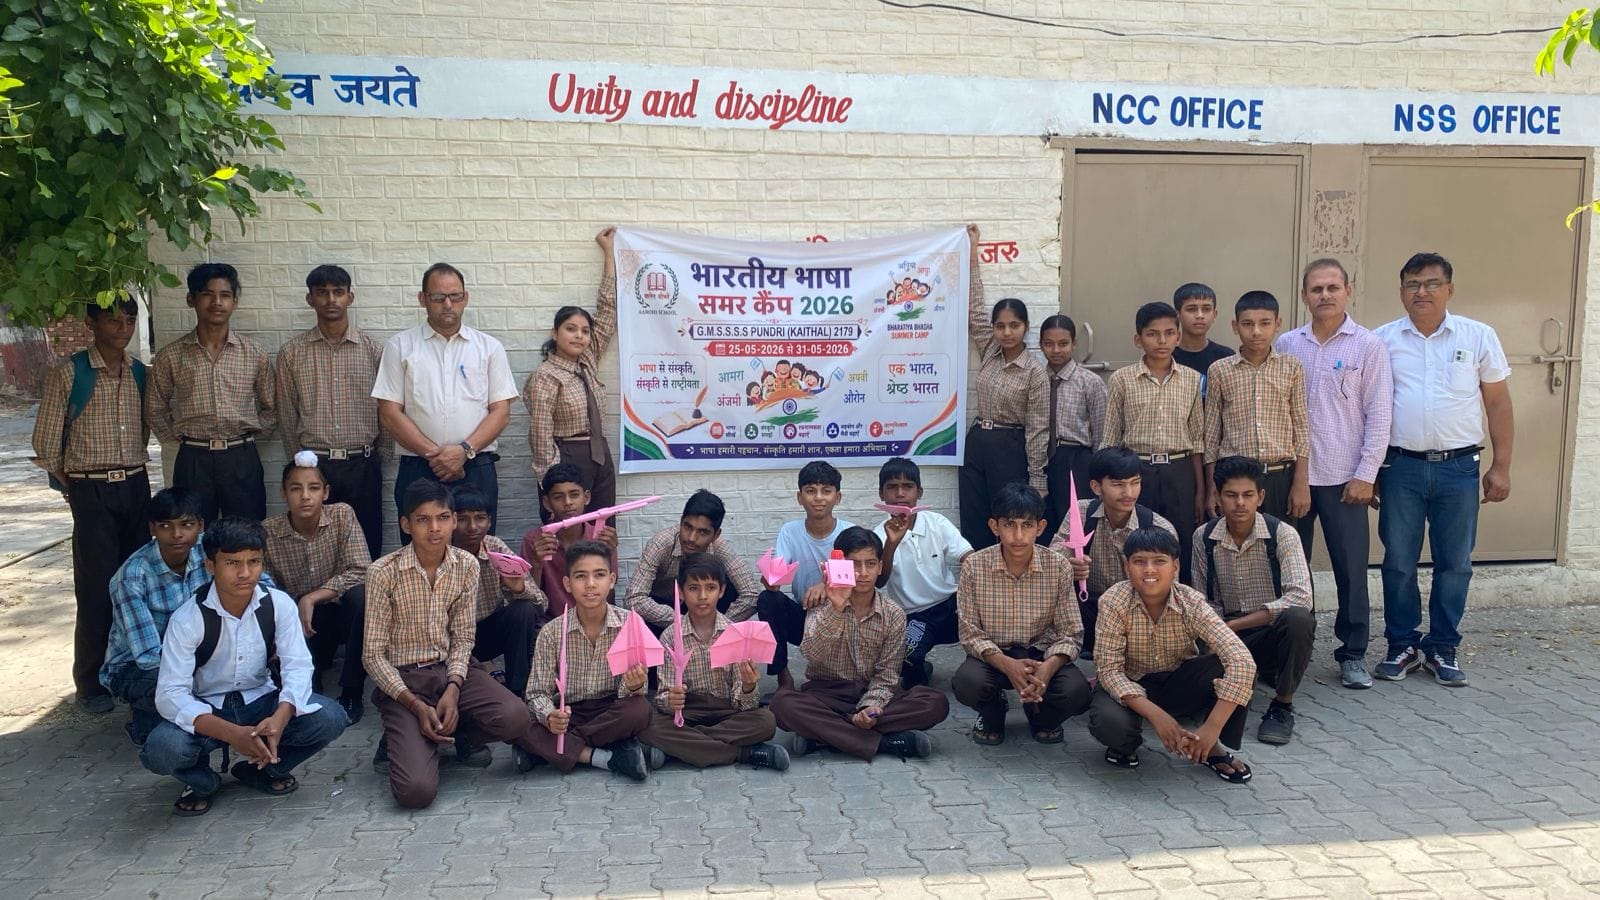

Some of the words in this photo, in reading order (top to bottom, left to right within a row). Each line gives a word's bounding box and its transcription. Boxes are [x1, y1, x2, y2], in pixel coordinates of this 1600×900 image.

[330, 66, 421, 108] जयते
[548, 72, 632, 123] Unity
[641, 78, 700, 118] and
[714, 80, 853, 130] discipline
[1092, 92, 1160, 126] NCC
[1170, 96, 1264, 131] OFFICE
[1394, 103, 1457, 134] NSS
[1473, 104, 1562, 136] OFFICE
[691, 256, 788, 289] भारतीय
[795, 266, 853, 289] भाषा
[698, 294, 747, 315] समर
[752, 289, 794, 316] कैंप
[800, 295, 854, 316] 2026
[697, 326, 749, 338] G.M.S.S.S.S
[750, 326, 785, 338] PUNDRI
[787, 326, 832, 339] (KAITHAL)
[834, 326, 853, 338] 2179
[887, 323, 913, 332] BHARATIYA
[914, 323, 933, 331] BHASHA
[891, 332, 914, 340] SUMMER
[914, 331, 929, 339] CAMP
[728, 344, 784, 355] 25-05-2026
[786, 343, 795, 355] से
[795, 343, 849, 355] 31-05-2026
[659, 360, 666, 373] से
[667, 361, 696, 376] संस्कृति,
[888, 363, 906, 377] एक
[909, 363, 937, 376] भारत,
[636, 376, 661, 392] संस्कृति
[662, 376, 669, 389] से
[671, 376, 700, 391] राष्ट्रीयता
[886, 379, 908, 395] श्रेष्ठ
[912, 382, 939, 395] भारत
[700, 446, 716, 455] भाषा
[718, 445, 736, 455] हमारी
[763, 445, 786, 457] संस्कृति
[788, 444, 806, 455] हमारी
[807, 446, 823, 455] शान,
[862, 443, 887, 453] अभियान
